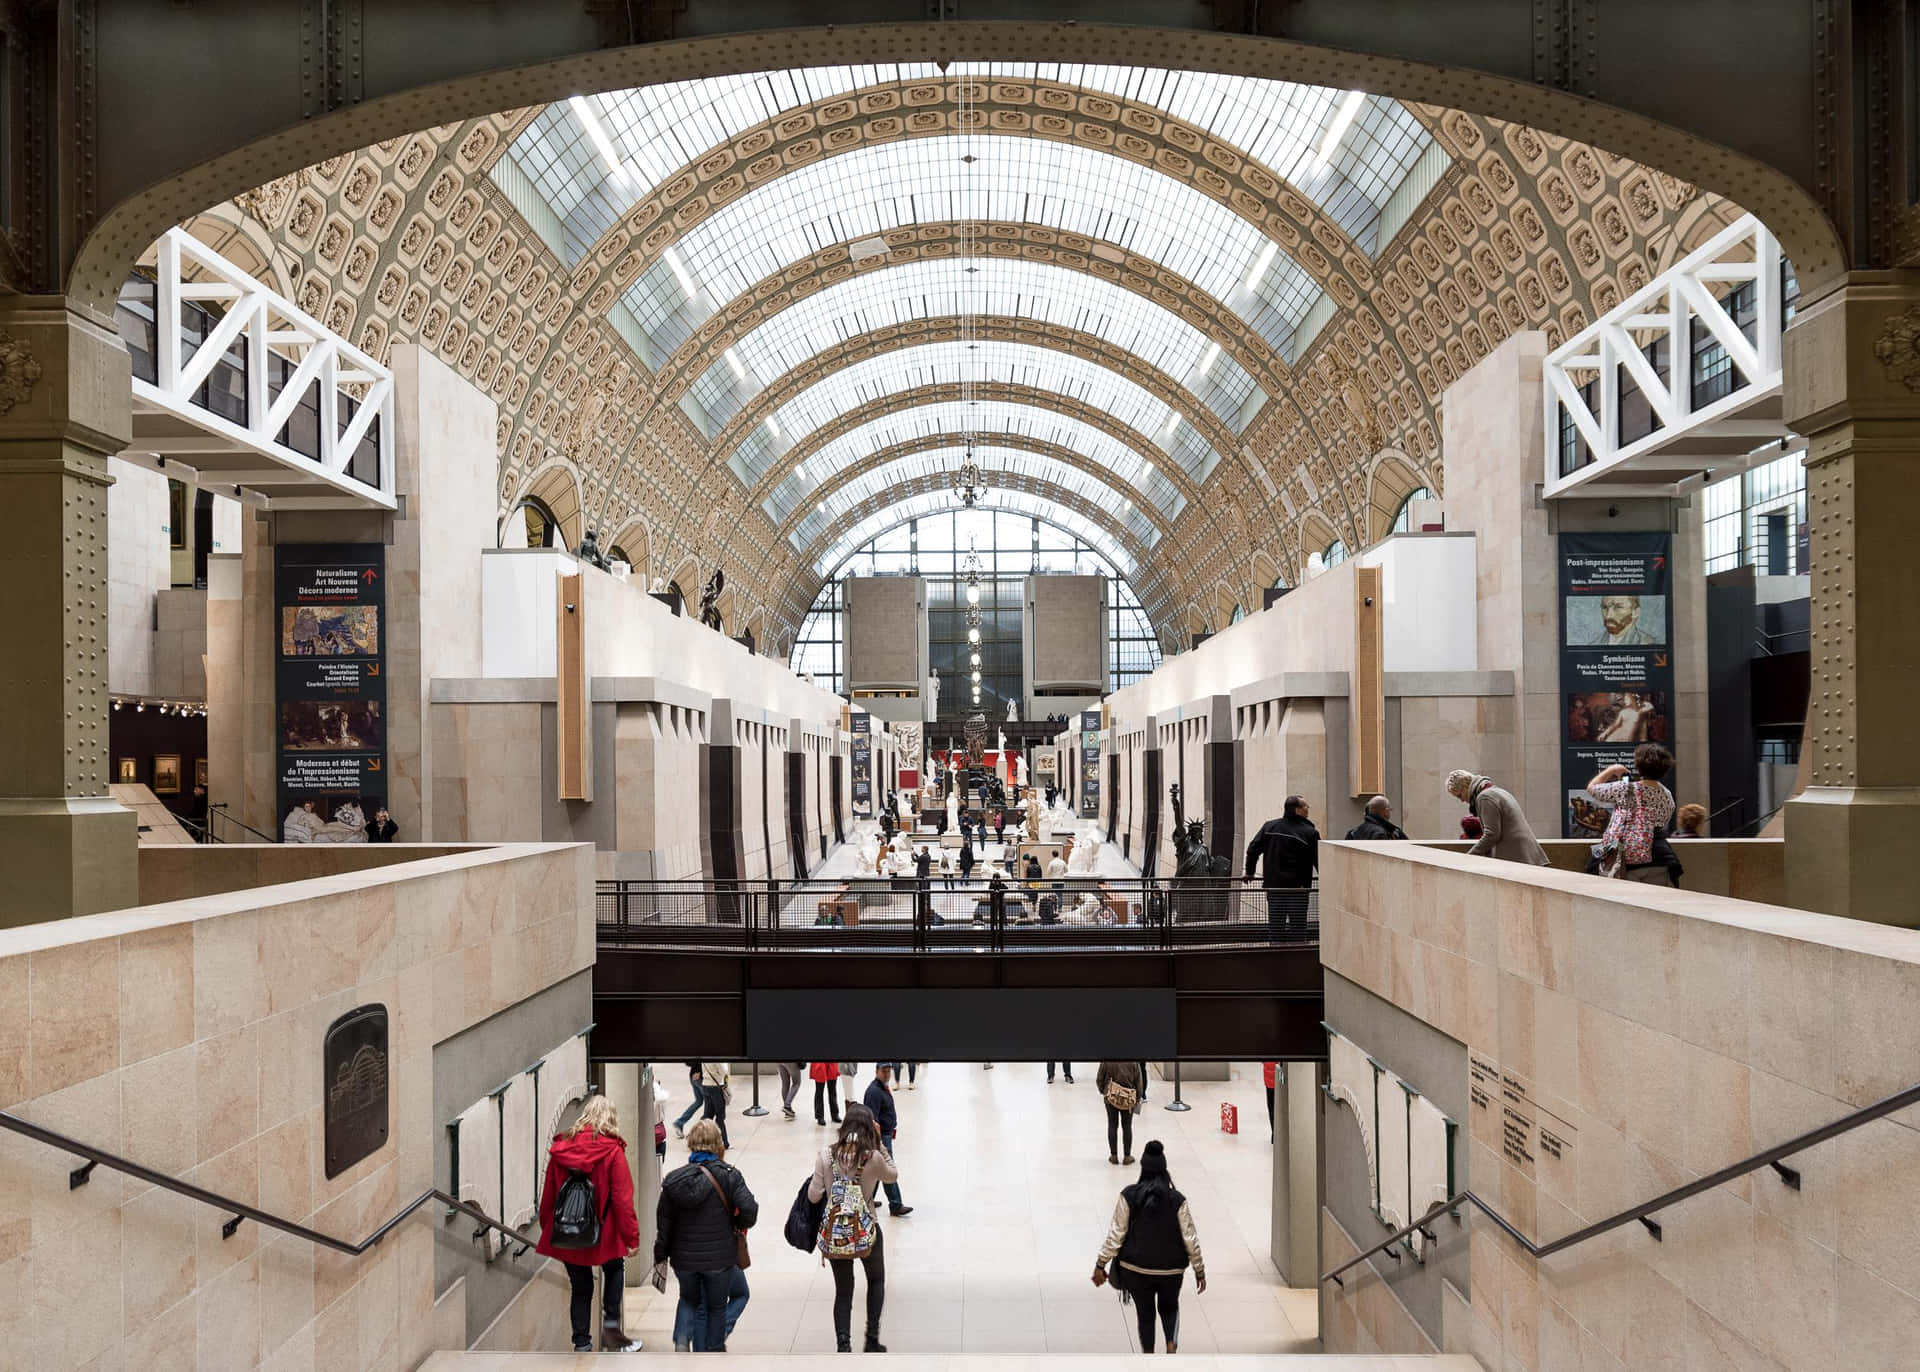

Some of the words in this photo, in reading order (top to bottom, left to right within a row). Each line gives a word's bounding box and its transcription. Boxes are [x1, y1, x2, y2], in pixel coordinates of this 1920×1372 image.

[1567, 558, 1645, 567] Post-impressionnisme
[316, 569, 358, 577] Naturalisme
[315, 578, 327, 586] Art
[327, 578, 358, 586] Nouveau
[298, 586, 323, 594] Décors
[324, 586, 358, 594] modernes
[1602, 655, 1645, 664] Symbolisme
[296, 759, 331, 767] Modernes
[331, 759, 339, 767] et
[340, 759, 360, 767] début
[297, 767, 360, 776] l'Impressionnisme
